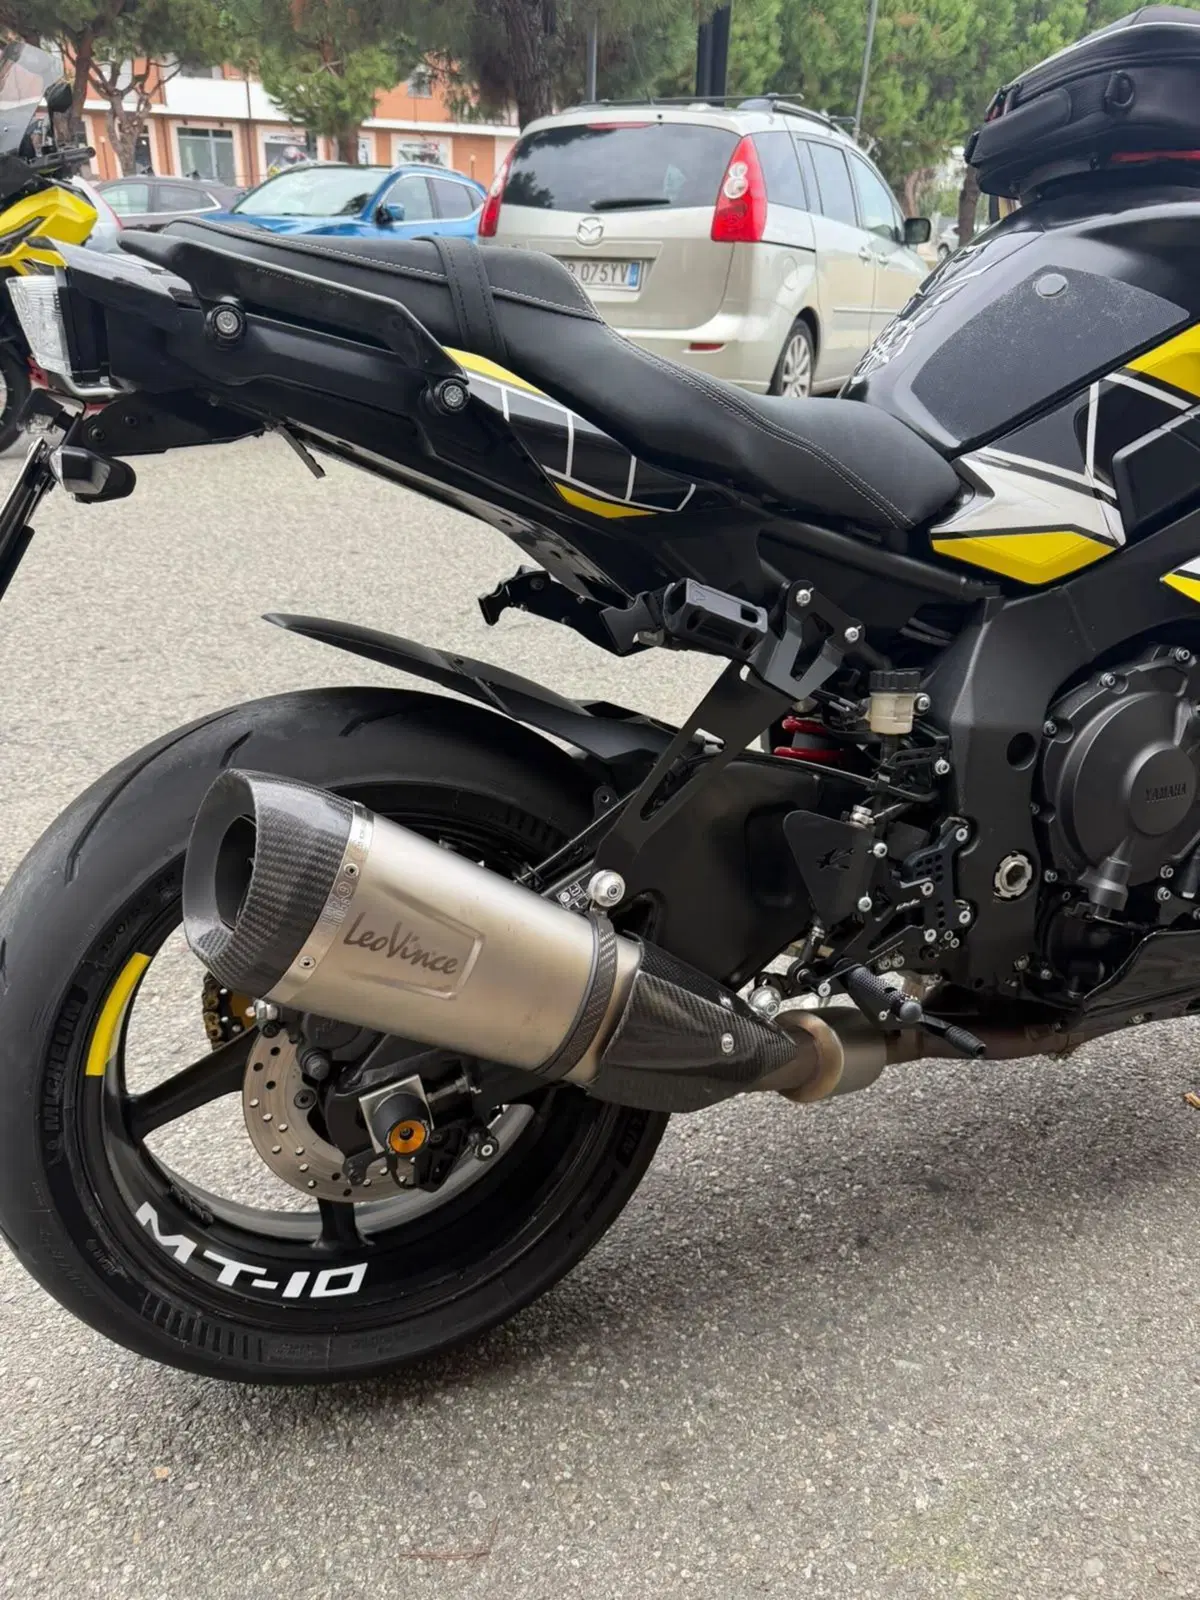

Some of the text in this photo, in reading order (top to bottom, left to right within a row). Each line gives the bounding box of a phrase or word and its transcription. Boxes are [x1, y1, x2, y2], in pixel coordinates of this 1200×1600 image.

[580, 262, 629, 282] 075YV
[1144, 782, 1186, 802] YAMAHA
[343, 911, 459, 975] LeoVince
[44, 1000, 81, 1132] MICHELIN
[135, 1201, 368, 1298] MT-10
